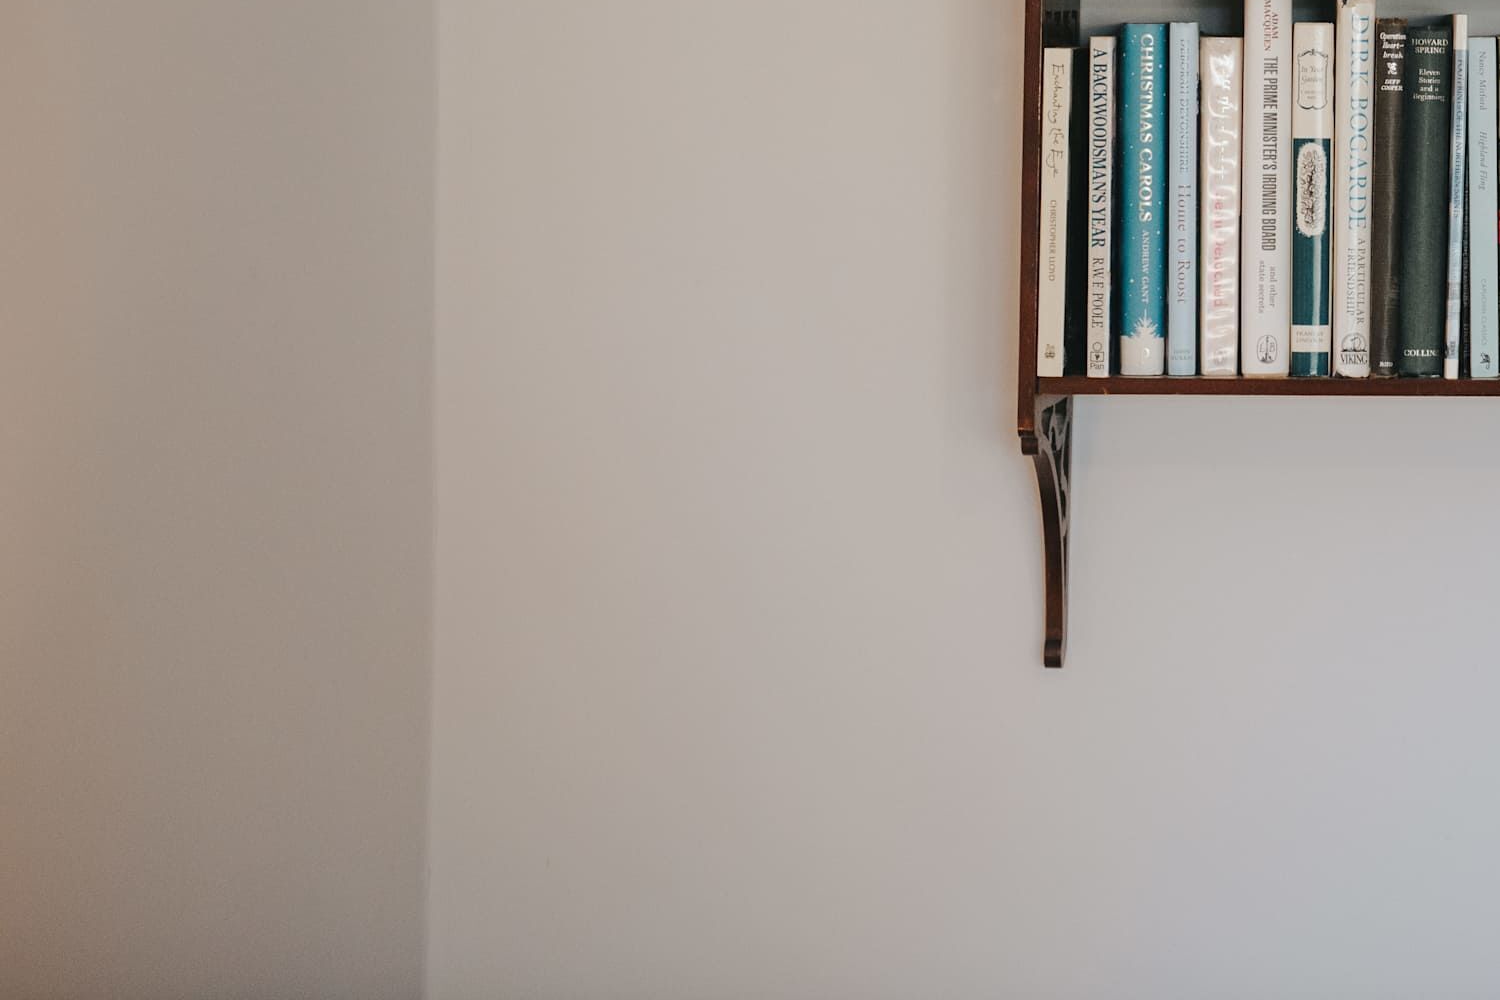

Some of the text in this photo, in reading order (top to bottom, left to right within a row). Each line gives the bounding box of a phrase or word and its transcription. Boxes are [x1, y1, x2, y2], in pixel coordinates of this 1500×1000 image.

[1262, 0, 1271, 52] MACQUEEN
[1270, 12, 1279, 39] ADAM
[1411, 38, 1448, 46] HOWARD
[1415, 46, 1445, 54] SPRING
[1477, 51, 1487, 77] Nancy
[1138, 33, 1154, 222] CHRISTMAS CAROLS
[1179, 38, 1189, 174] DEBORAH DEVONSHIRE
[1347, 15, 1370, 230] DIRK BOGARDE
[1091, 48, 1108, 248] A BACKWOODSMAN'S YEAR
[1261, 56, 1279, 251] THE PRIME MINISTER'S IRONING BOARD
[1477, 131, 1488, 191] Highland Fling
[1047, 200, 1057, 282] CHRISTOPHER LLOYD
[1141, 230, 1150, 303] ANDREW GANT
[1176, 185, 1191, 304] Home to Roost
[1257, 260, 1266, 313] state secrets
[1268, 266, 1277, 308] and other
[1345, 248, 1356, 316] FRIENDSHIP
[1355, 238, 1366, 325] A PARTICULAR
[1340, 353, 1368, 365] VIKING
